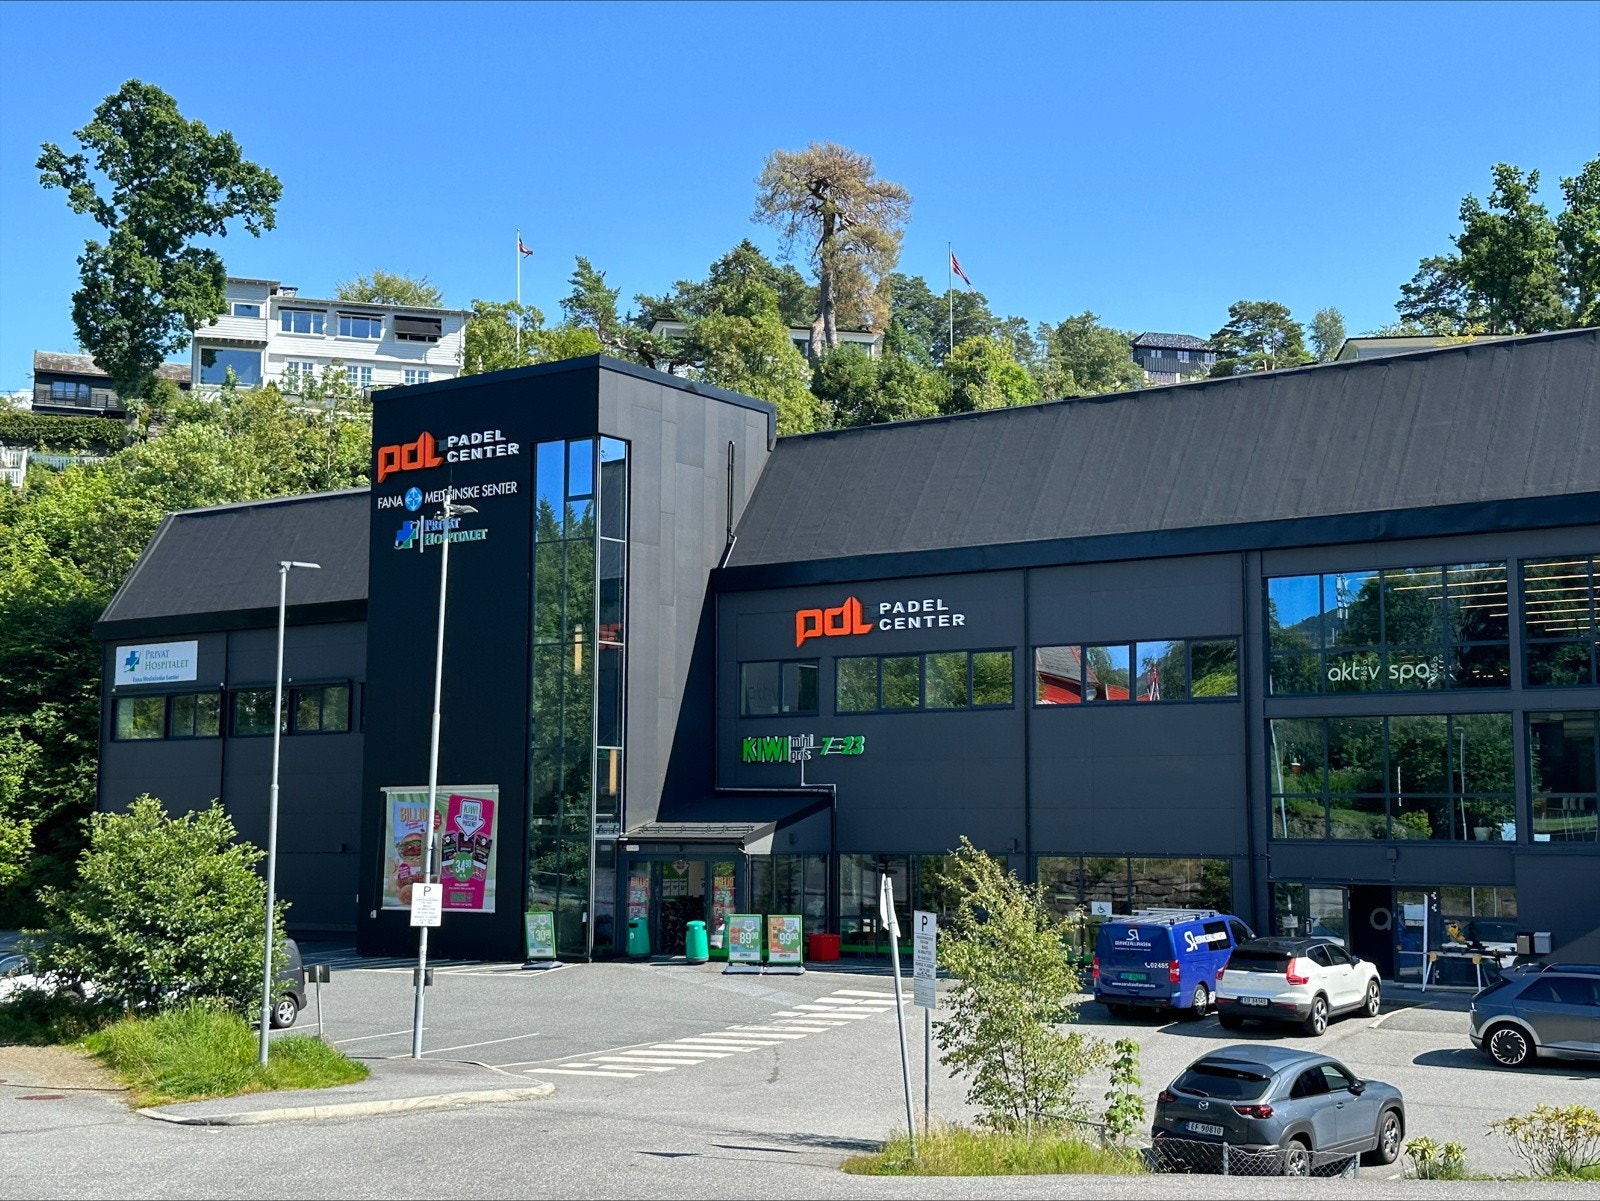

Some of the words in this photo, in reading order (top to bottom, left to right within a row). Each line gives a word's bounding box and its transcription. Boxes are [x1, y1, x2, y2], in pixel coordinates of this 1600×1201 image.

[447, 430, 506, 448] PADEL
[447, 442, 520, 463] CENTER
[377, 495, 403, 509] FANA
[482, 481, 517, 497] SENTER
[879, 598, 949, 615] PADEL
[879, 614, 966, 631] CENTER
[145, 650, 170, 659] PRIVAT
[145, 660, 189, 670] HOSPITALET
[1388, 663, 1430, 684] spa
[742, 736, 790, 762] KIWI
[424, 886, 431, 896] P
[922, 915, 928, 932] P
[1202, 1124, 1222, 1134] 90810
